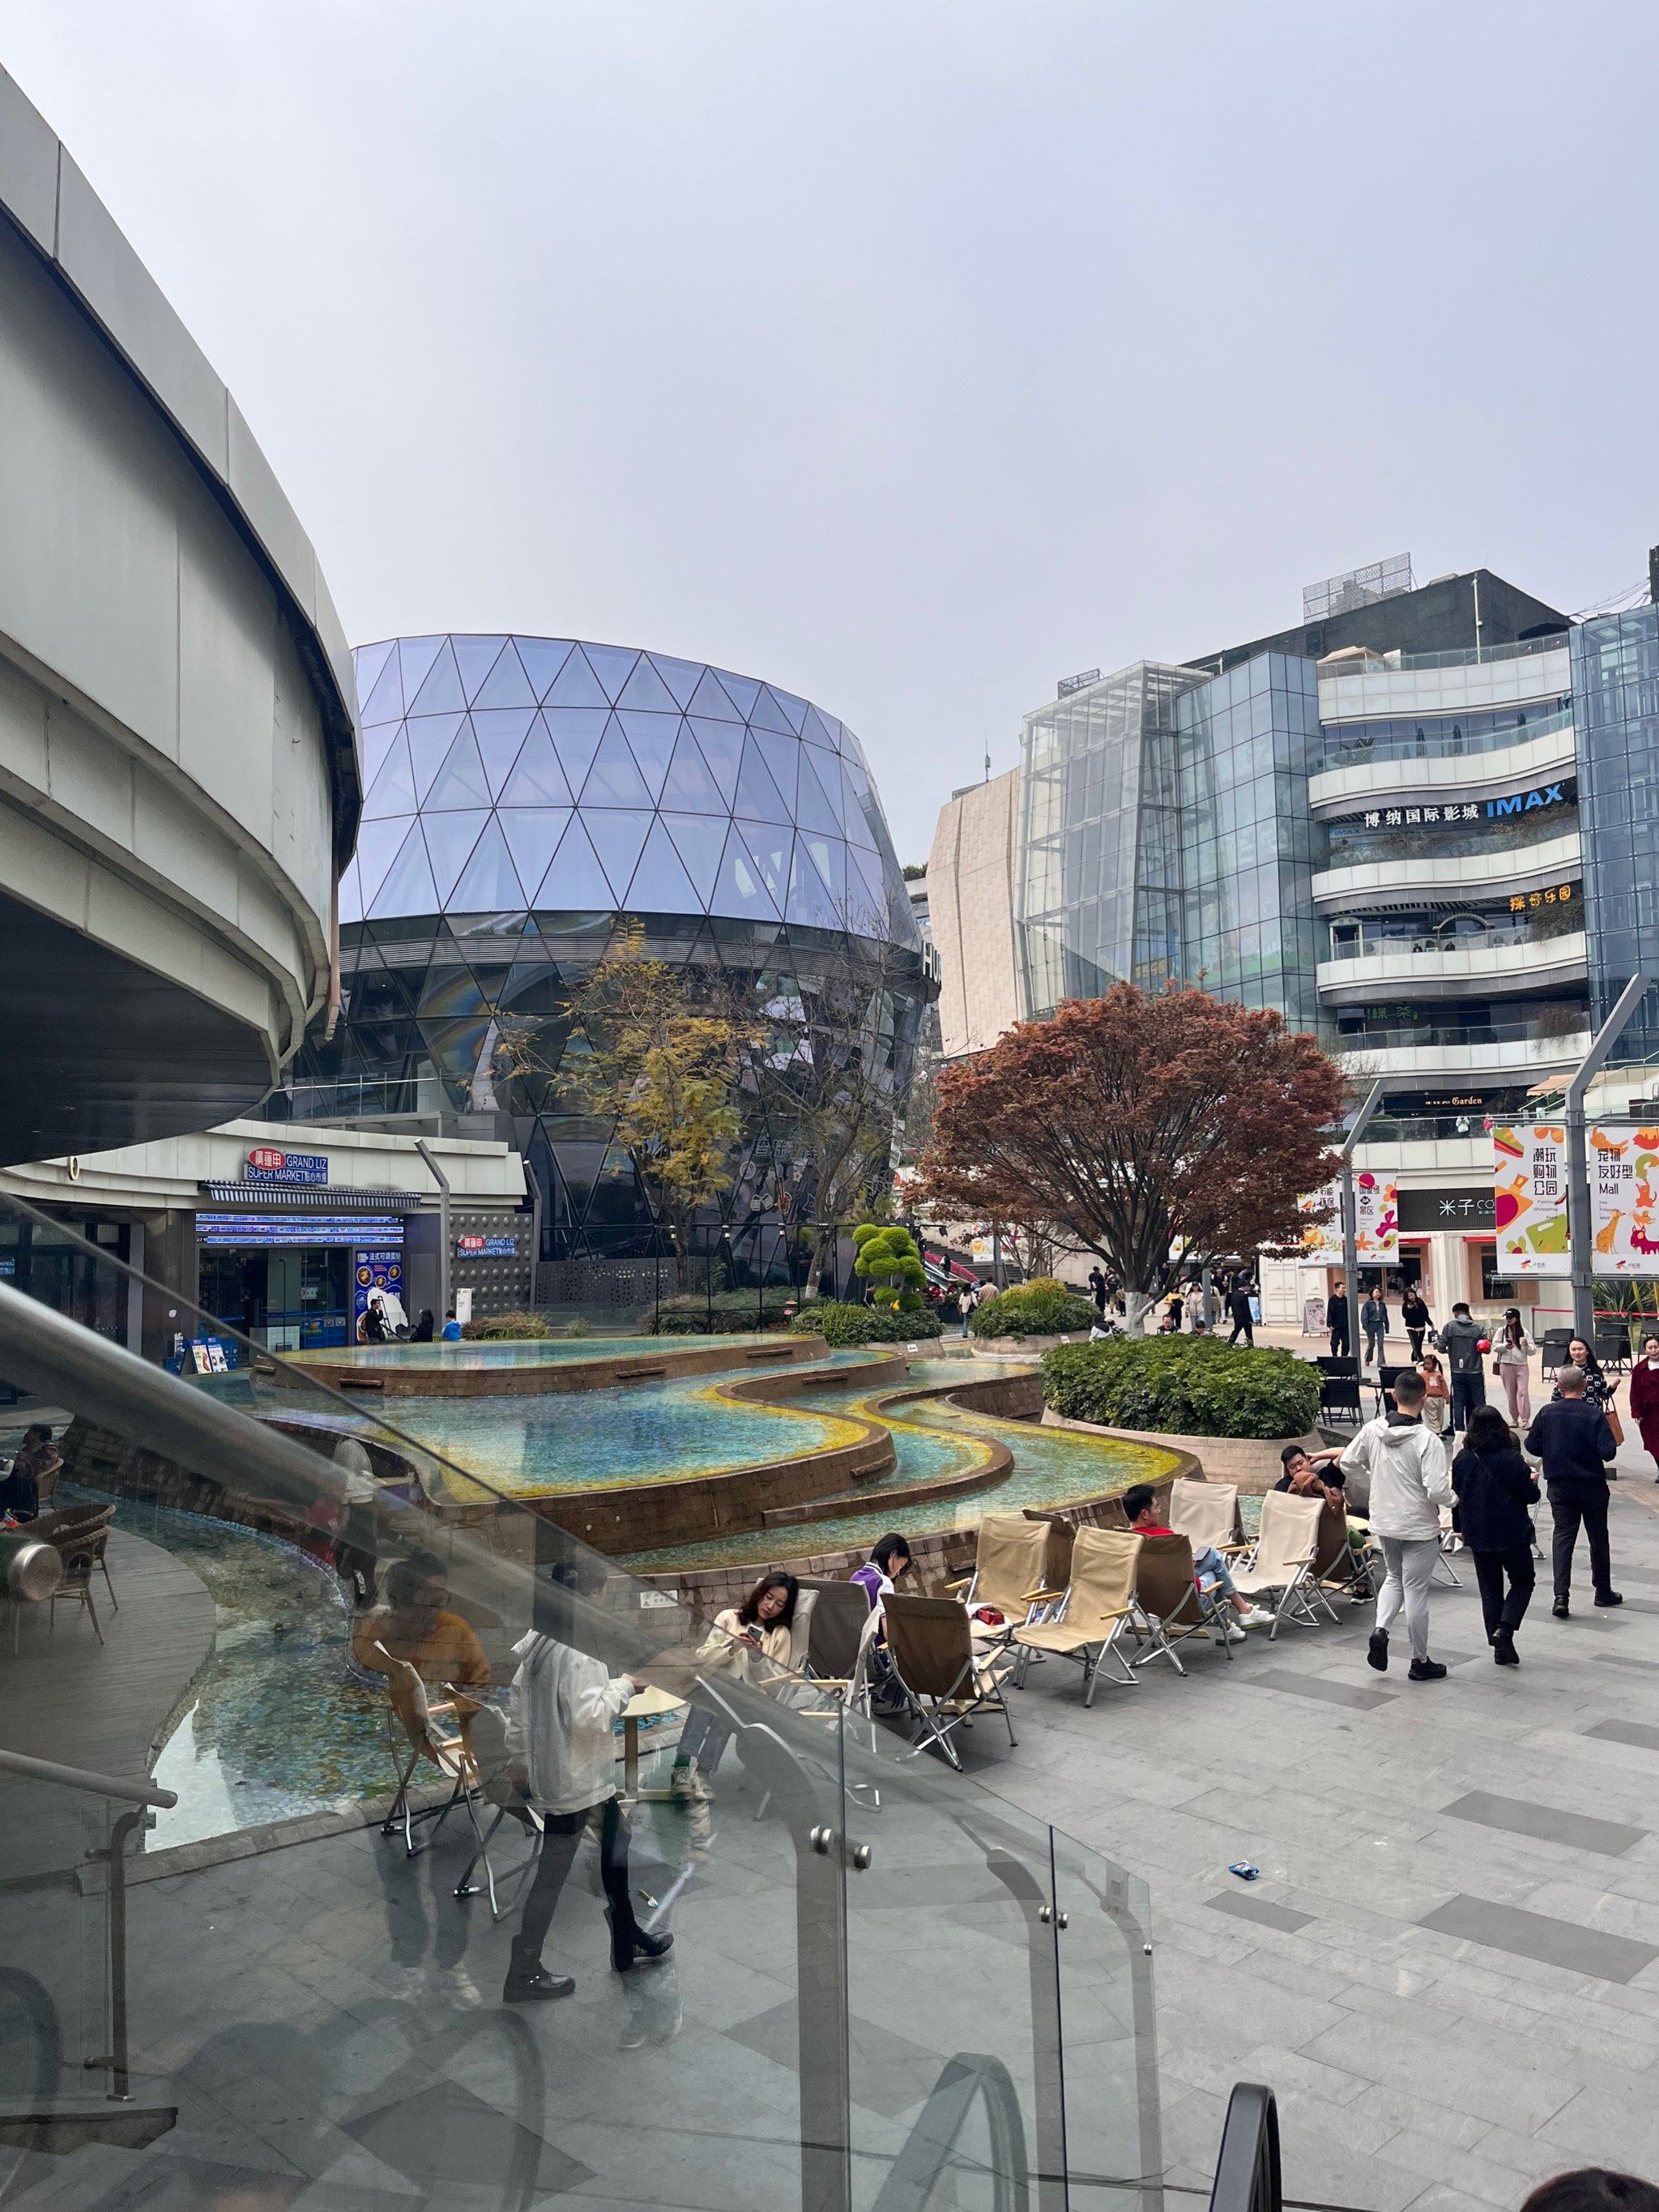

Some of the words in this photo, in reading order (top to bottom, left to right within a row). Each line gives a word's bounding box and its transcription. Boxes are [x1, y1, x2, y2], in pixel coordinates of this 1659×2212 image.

[1364, 805, 1479, 827] 博纳国际影城
[1486, 784, 1563, 818] IMAX
[1335, 828, 1360, 836] IMAX
[1509, 885, 1571, 912] 探奇乐园
[1452, 1095, 1482, 1106] Garden
[1533, 1147, 1556, 1162] 潮玩
[1597, 1147, 1621, 1162] 宠物
[286, 1155, 314, 1168] GRAND
[315, 1158, 327, 1169] LIZ
[248, 1167, 274, 1180] SUPER
[275, 1169, 305, 1181] MARKET
[1533, 1164, 1557, 1179] 购物
[1598, 1164, 1633, 1179] 友好型
[1533, 1181, 1558, 1195] 公园
[1599, 1183, 1618, 1194] Mall
[1439, 1199, 1475, 1215] 米子
[486, 1238, 505, 1246] GRAND
[505, 1238, 515, 1246] LIZ
[460, 1248, 477, 1256] SUPER
[478, 1248, 499, 1256] MARKET
